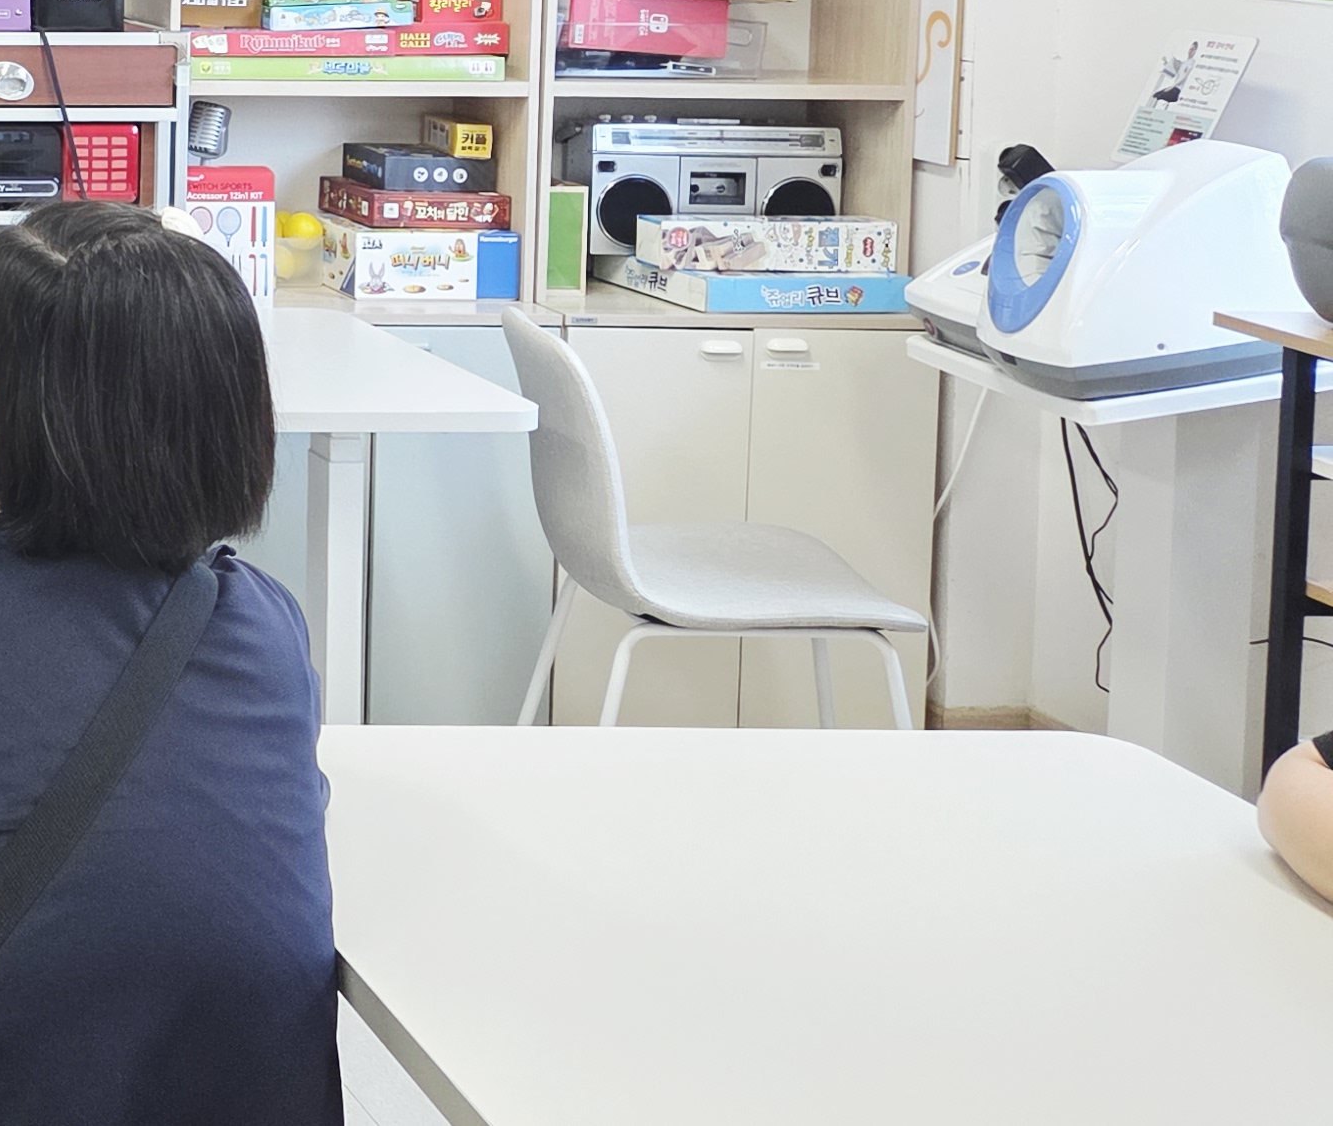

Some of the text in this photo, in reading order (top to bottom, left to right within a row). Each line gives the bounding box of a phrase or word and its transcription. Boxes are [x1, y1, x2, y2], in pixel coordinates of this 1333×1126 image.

[240, 34, 326, 53] Rummikub
[400, 40, 430, 48] GALLI
[187, 192, 228, 200] Accessory
[807, 286, 842, 307] 큐브
